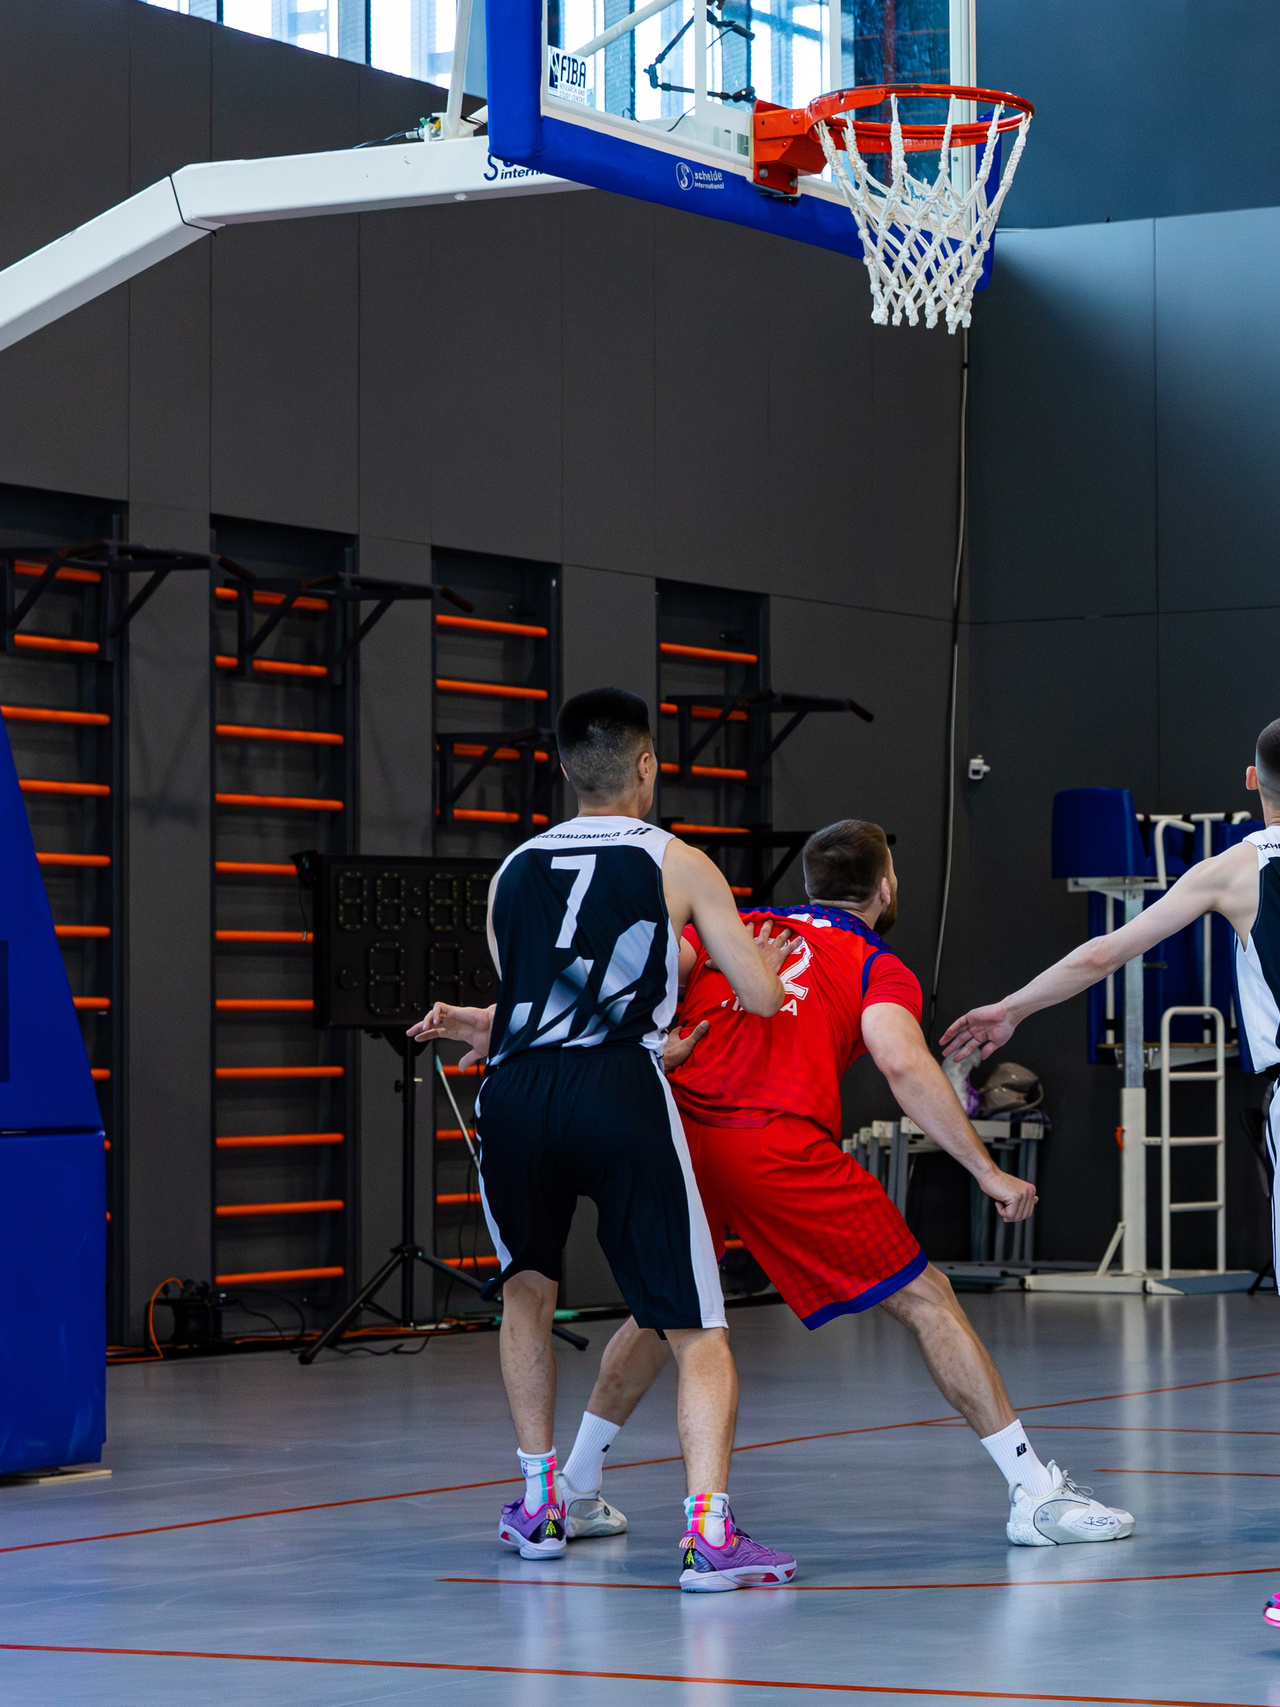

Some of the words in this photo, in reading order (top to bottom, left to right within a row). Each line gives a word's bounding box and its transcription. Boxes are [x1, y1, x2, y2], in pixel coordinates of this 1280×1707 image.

[561, 55, 586, 88] FIBA
[694, 170, 723, 181] schelde
[694, 181, 724, 189] international
[551, 854, 597, 948] 7
